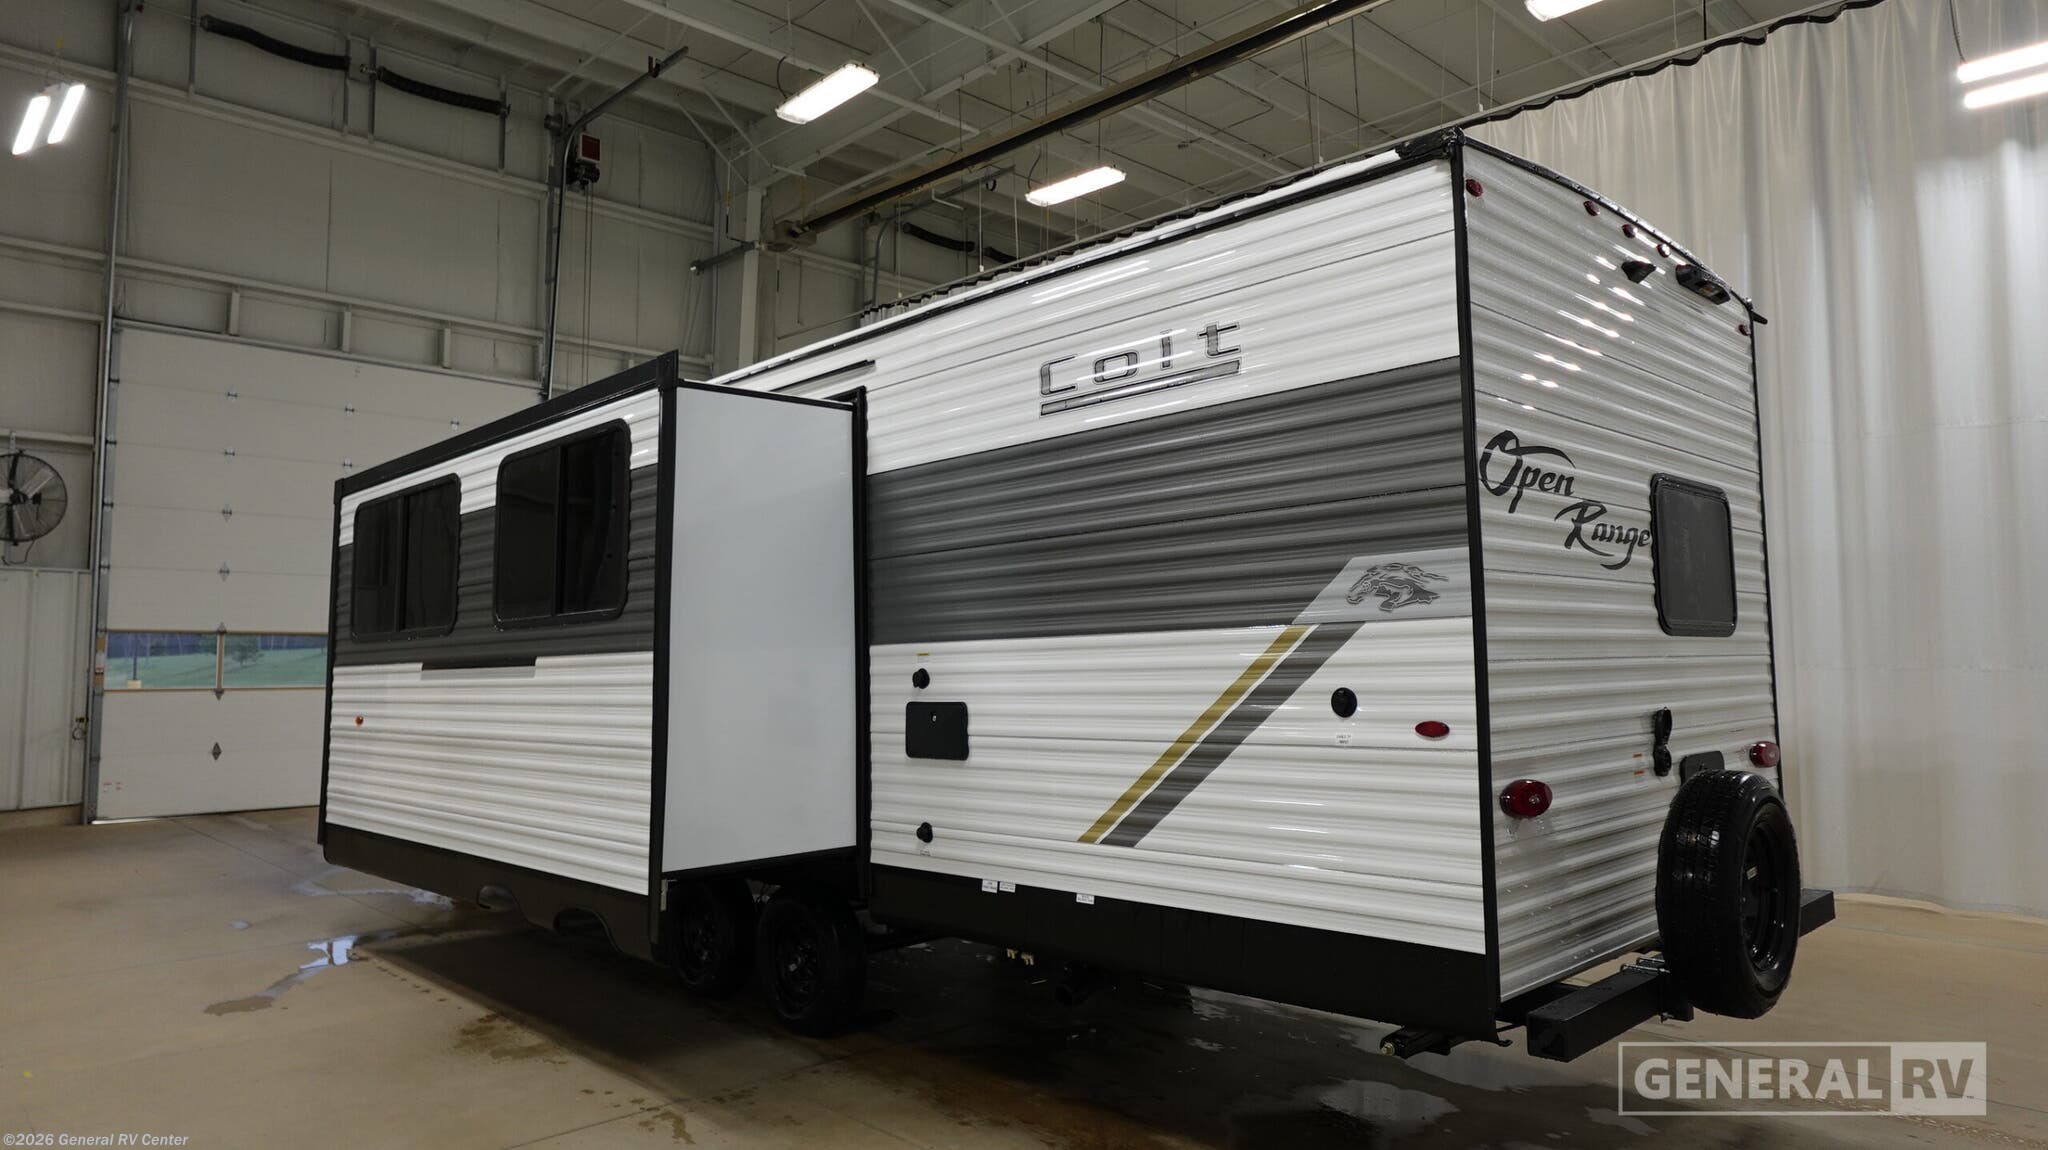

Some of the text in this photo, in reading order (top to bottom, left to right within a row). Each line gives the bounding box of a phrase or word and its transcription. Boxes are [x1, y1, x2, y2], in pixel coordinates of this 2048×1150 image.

[1040, 321, 1242, 396] Colt
[1479, 430, 1576, 514] Open
[1554, 500, 1651, 570] Range
